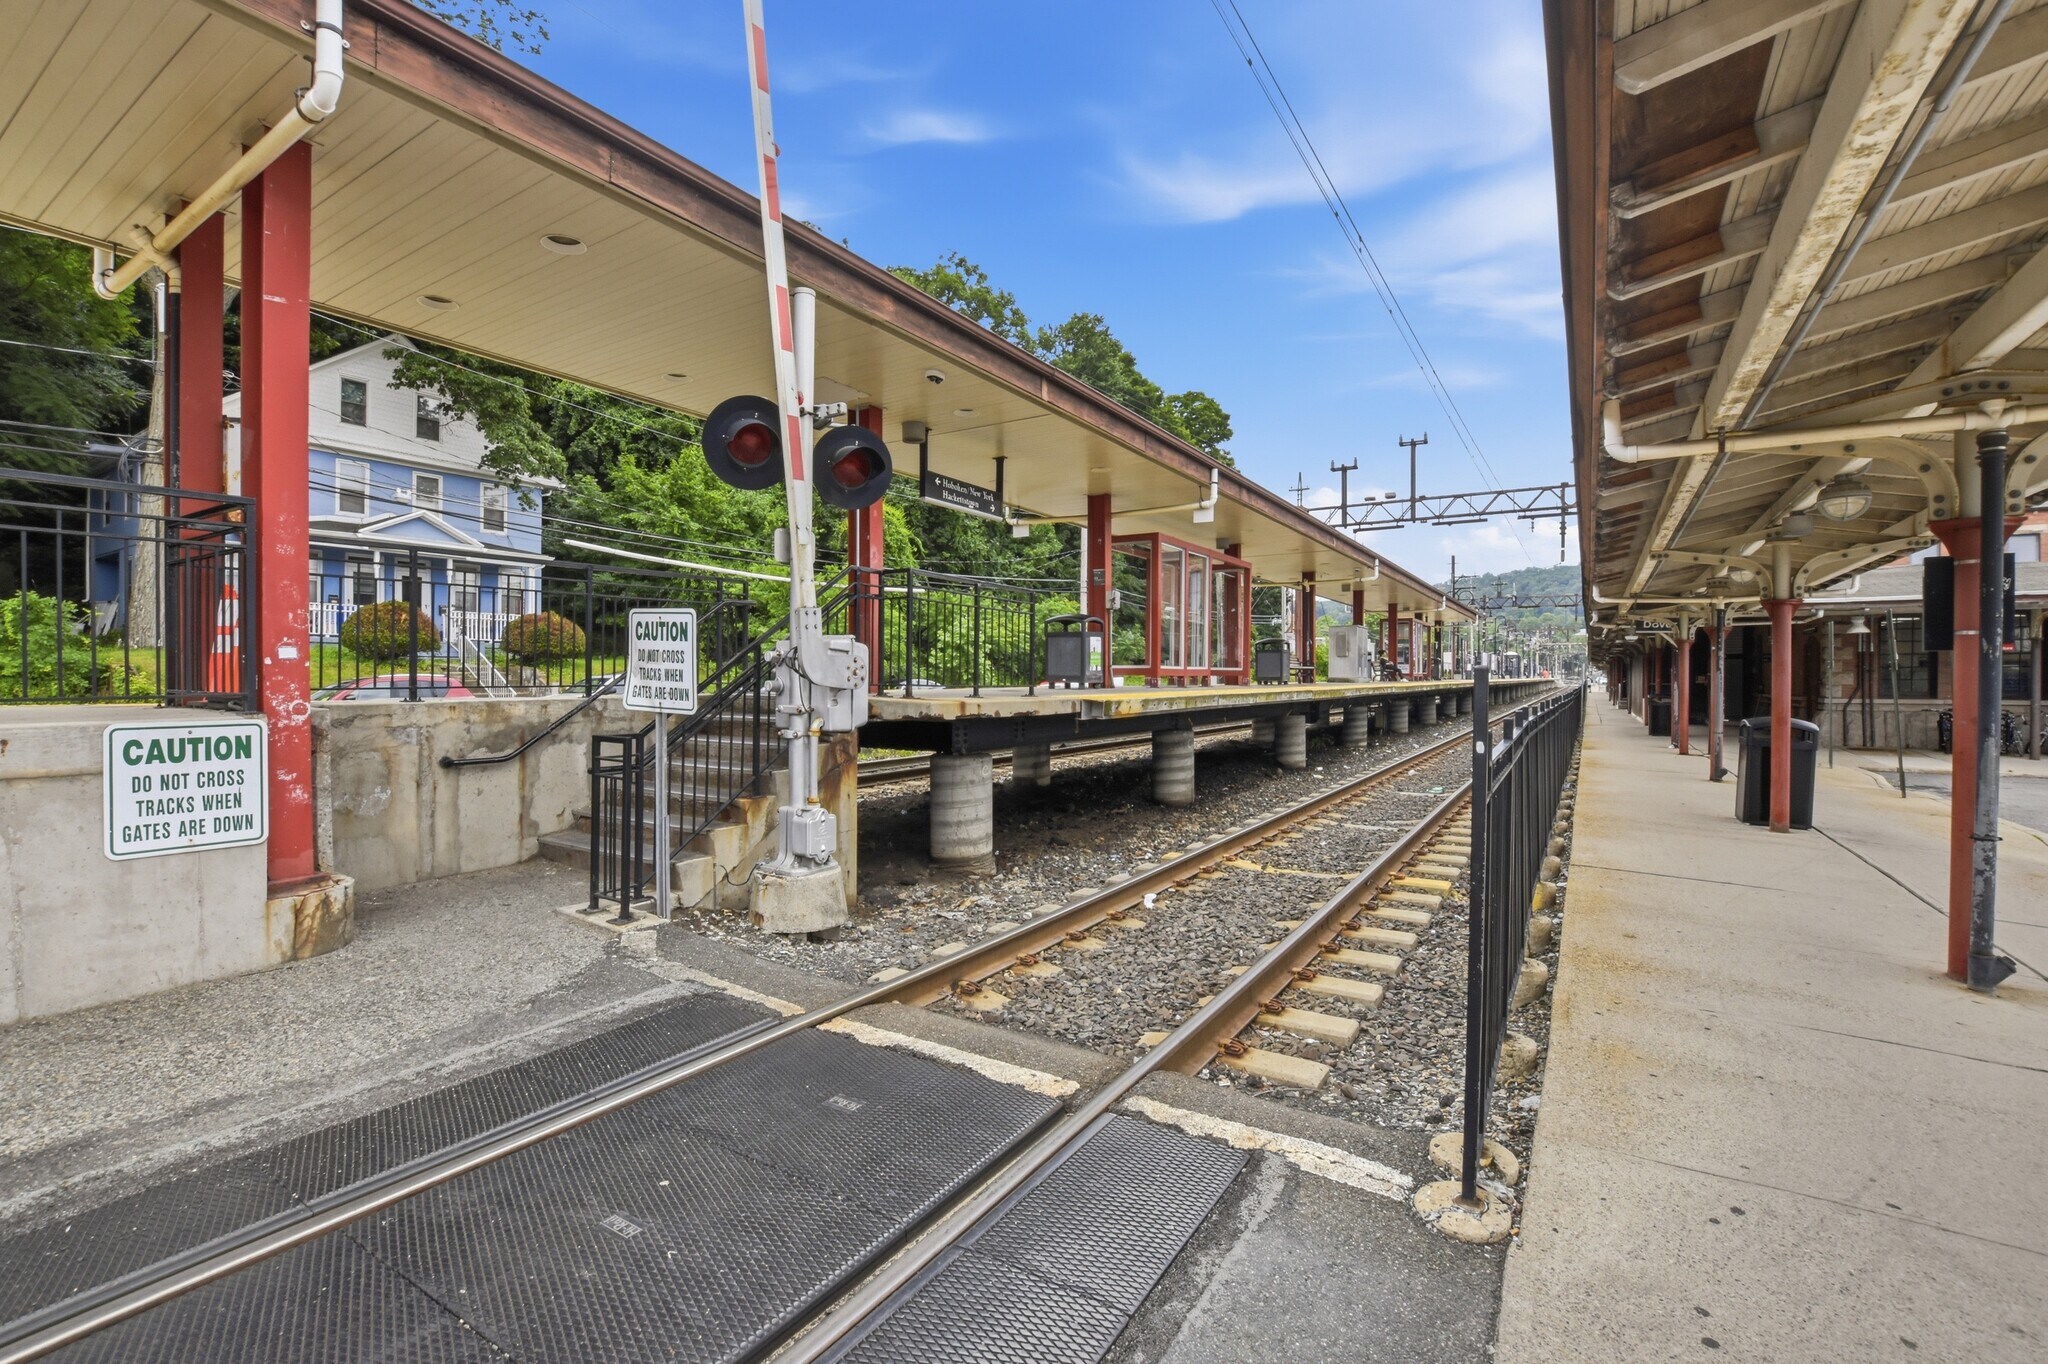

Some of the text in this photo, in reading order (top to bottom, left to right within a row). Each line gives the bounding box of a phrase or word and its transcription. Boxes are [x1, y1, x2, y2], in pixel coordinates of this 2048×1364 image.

[635, 621, 688, 642] CAUTION
[1643, 620, 1677, 629] Dov
[638, 648, 685, 664] DO NOT CROSS
[639, 667, 683, 682] TRACKS WHEN
[632, 685, 690, 702] GATES ARE DOWN
[122, 735, 252, 766] CAUTION
[132, 769, 245, 793] DO NOT CROSS
[136, 792, 242, 817] TRACKS WHEN
[122, 814, 253, 843] GATES ARE DOWN
